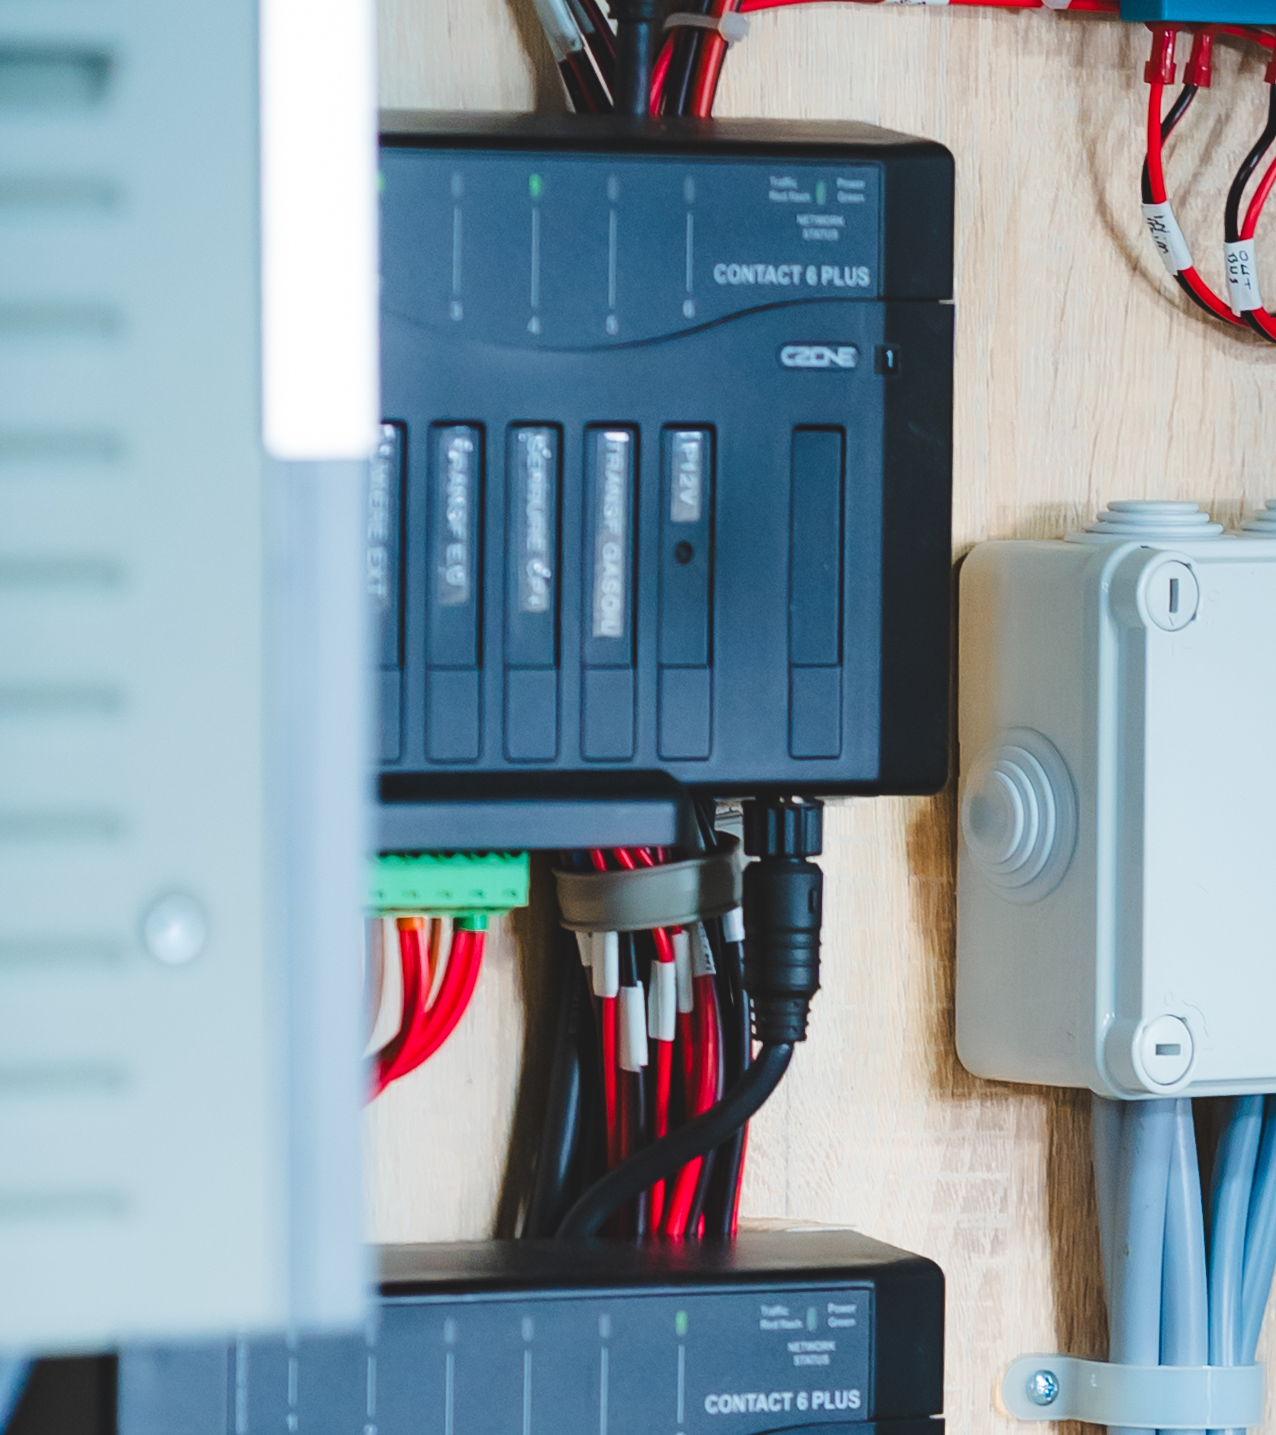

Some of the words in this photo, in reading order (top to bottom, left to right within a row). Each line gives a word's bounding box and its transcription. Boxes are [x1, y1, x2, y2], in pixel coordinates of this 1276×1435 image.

[713, 263, 803, 286] CONTACT
[806, 265, 817, 286] 6
[821, 266, 870, 287] PLUS
[781, 346, 859, 368] CZONE
[886, 350, 893, 368] 1
[787, 1341, 836, 1352] NETWORK
[793, 1354, 830, 1366] STATUS
[705, 1392, 794, 1414] CONTACT
[797, 1392, 808, 1410] 6
[812, 1389, 861, 1410] PLUS
